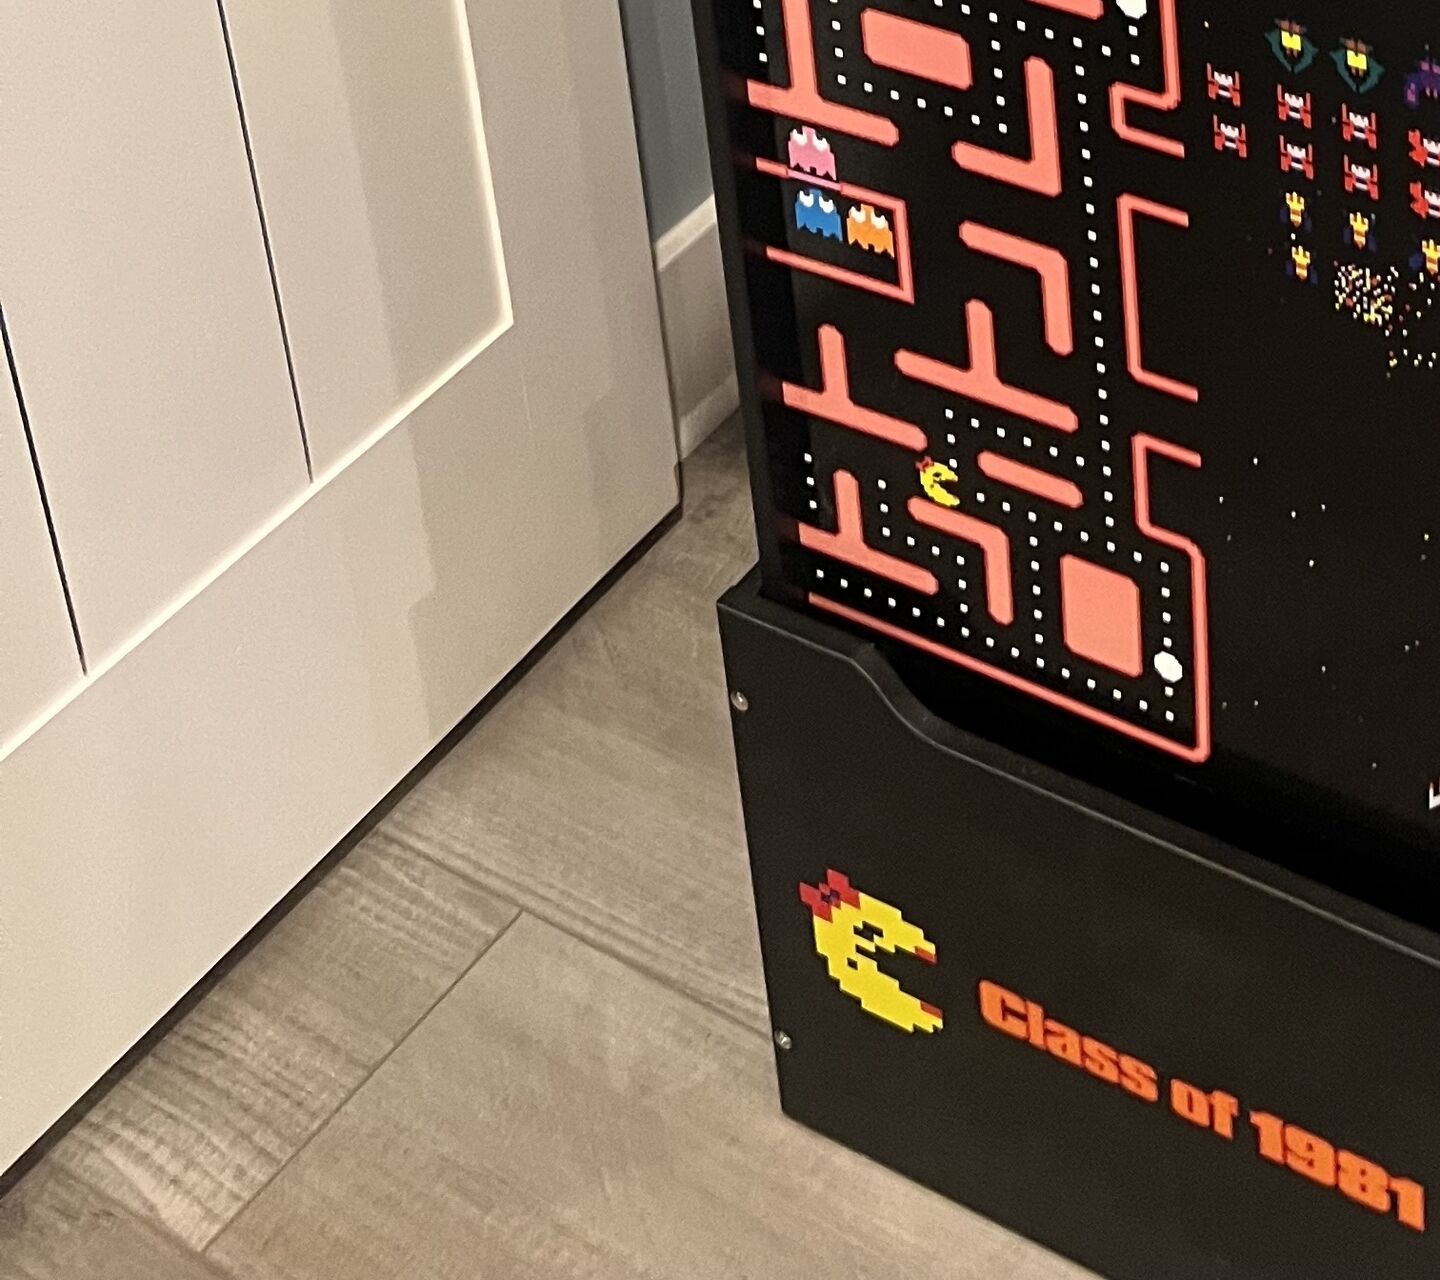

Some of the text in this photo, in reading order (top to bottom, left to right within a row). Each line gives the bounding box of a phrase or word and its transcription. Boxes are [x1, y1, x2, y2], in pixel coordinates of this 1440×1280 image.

[979, 979, 1425, 1232] Class of 1981
